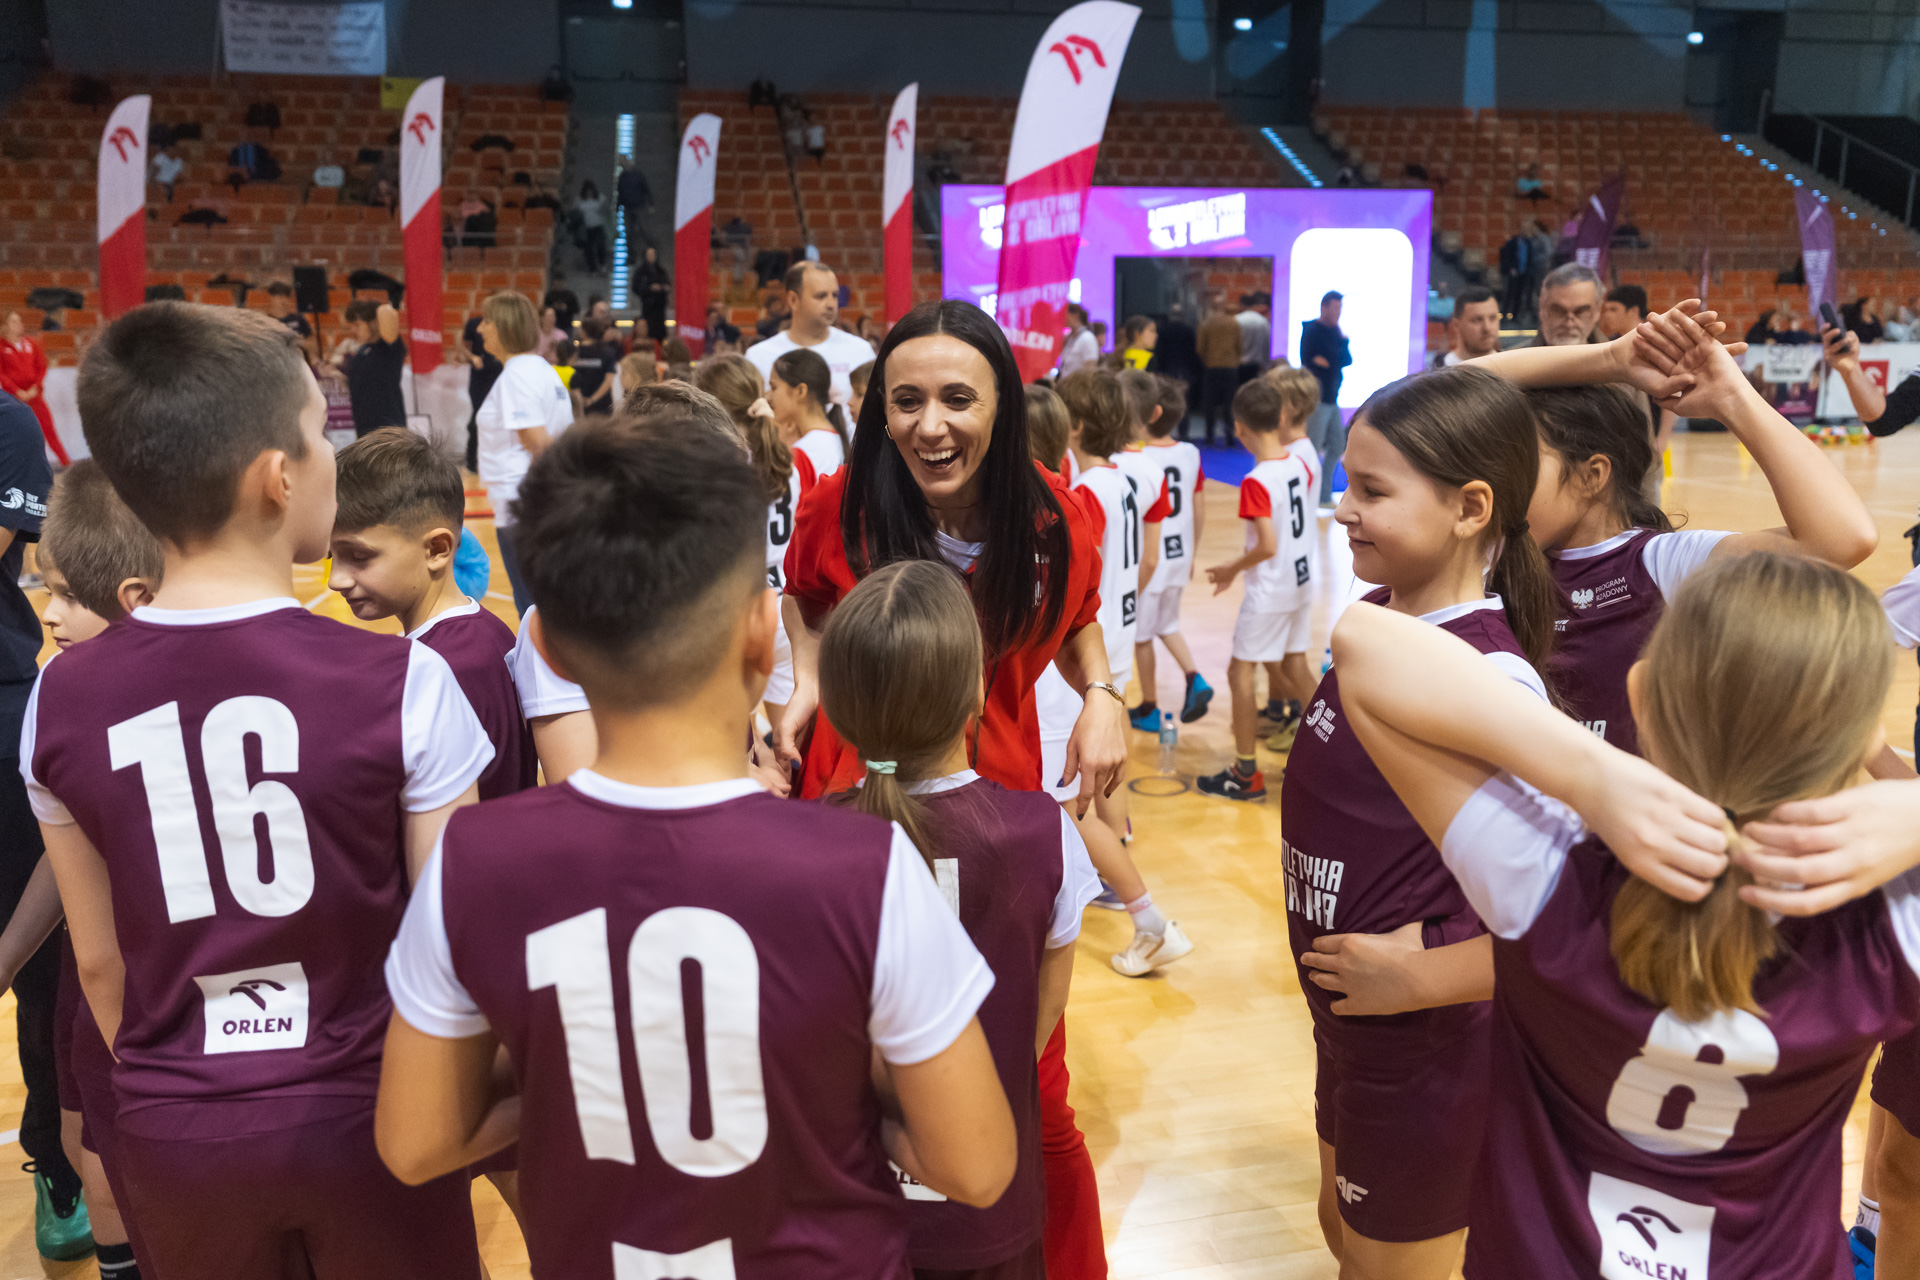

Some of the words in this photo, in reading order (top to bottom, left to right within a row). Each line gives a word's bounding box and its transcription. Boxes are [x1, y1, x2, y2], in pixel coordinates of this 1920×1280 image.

[769, 478, 792, 546] 3
[1163, 466, 1182, 518] 6
[1288, 477, 1305, 539] 5
[1595, 576, 1626, 594] PROGRAM
[1596, 584, 1628, 602] RZĄDOWY
[107, 695, 316, 924] 16
[222, 1017, 293, 1036] ORLEN
[525, 906, 769, 1178] 10
[1606, 1006, 1780, 1156] 8
[1618, 1250, 1688, 1280] ORLEN
